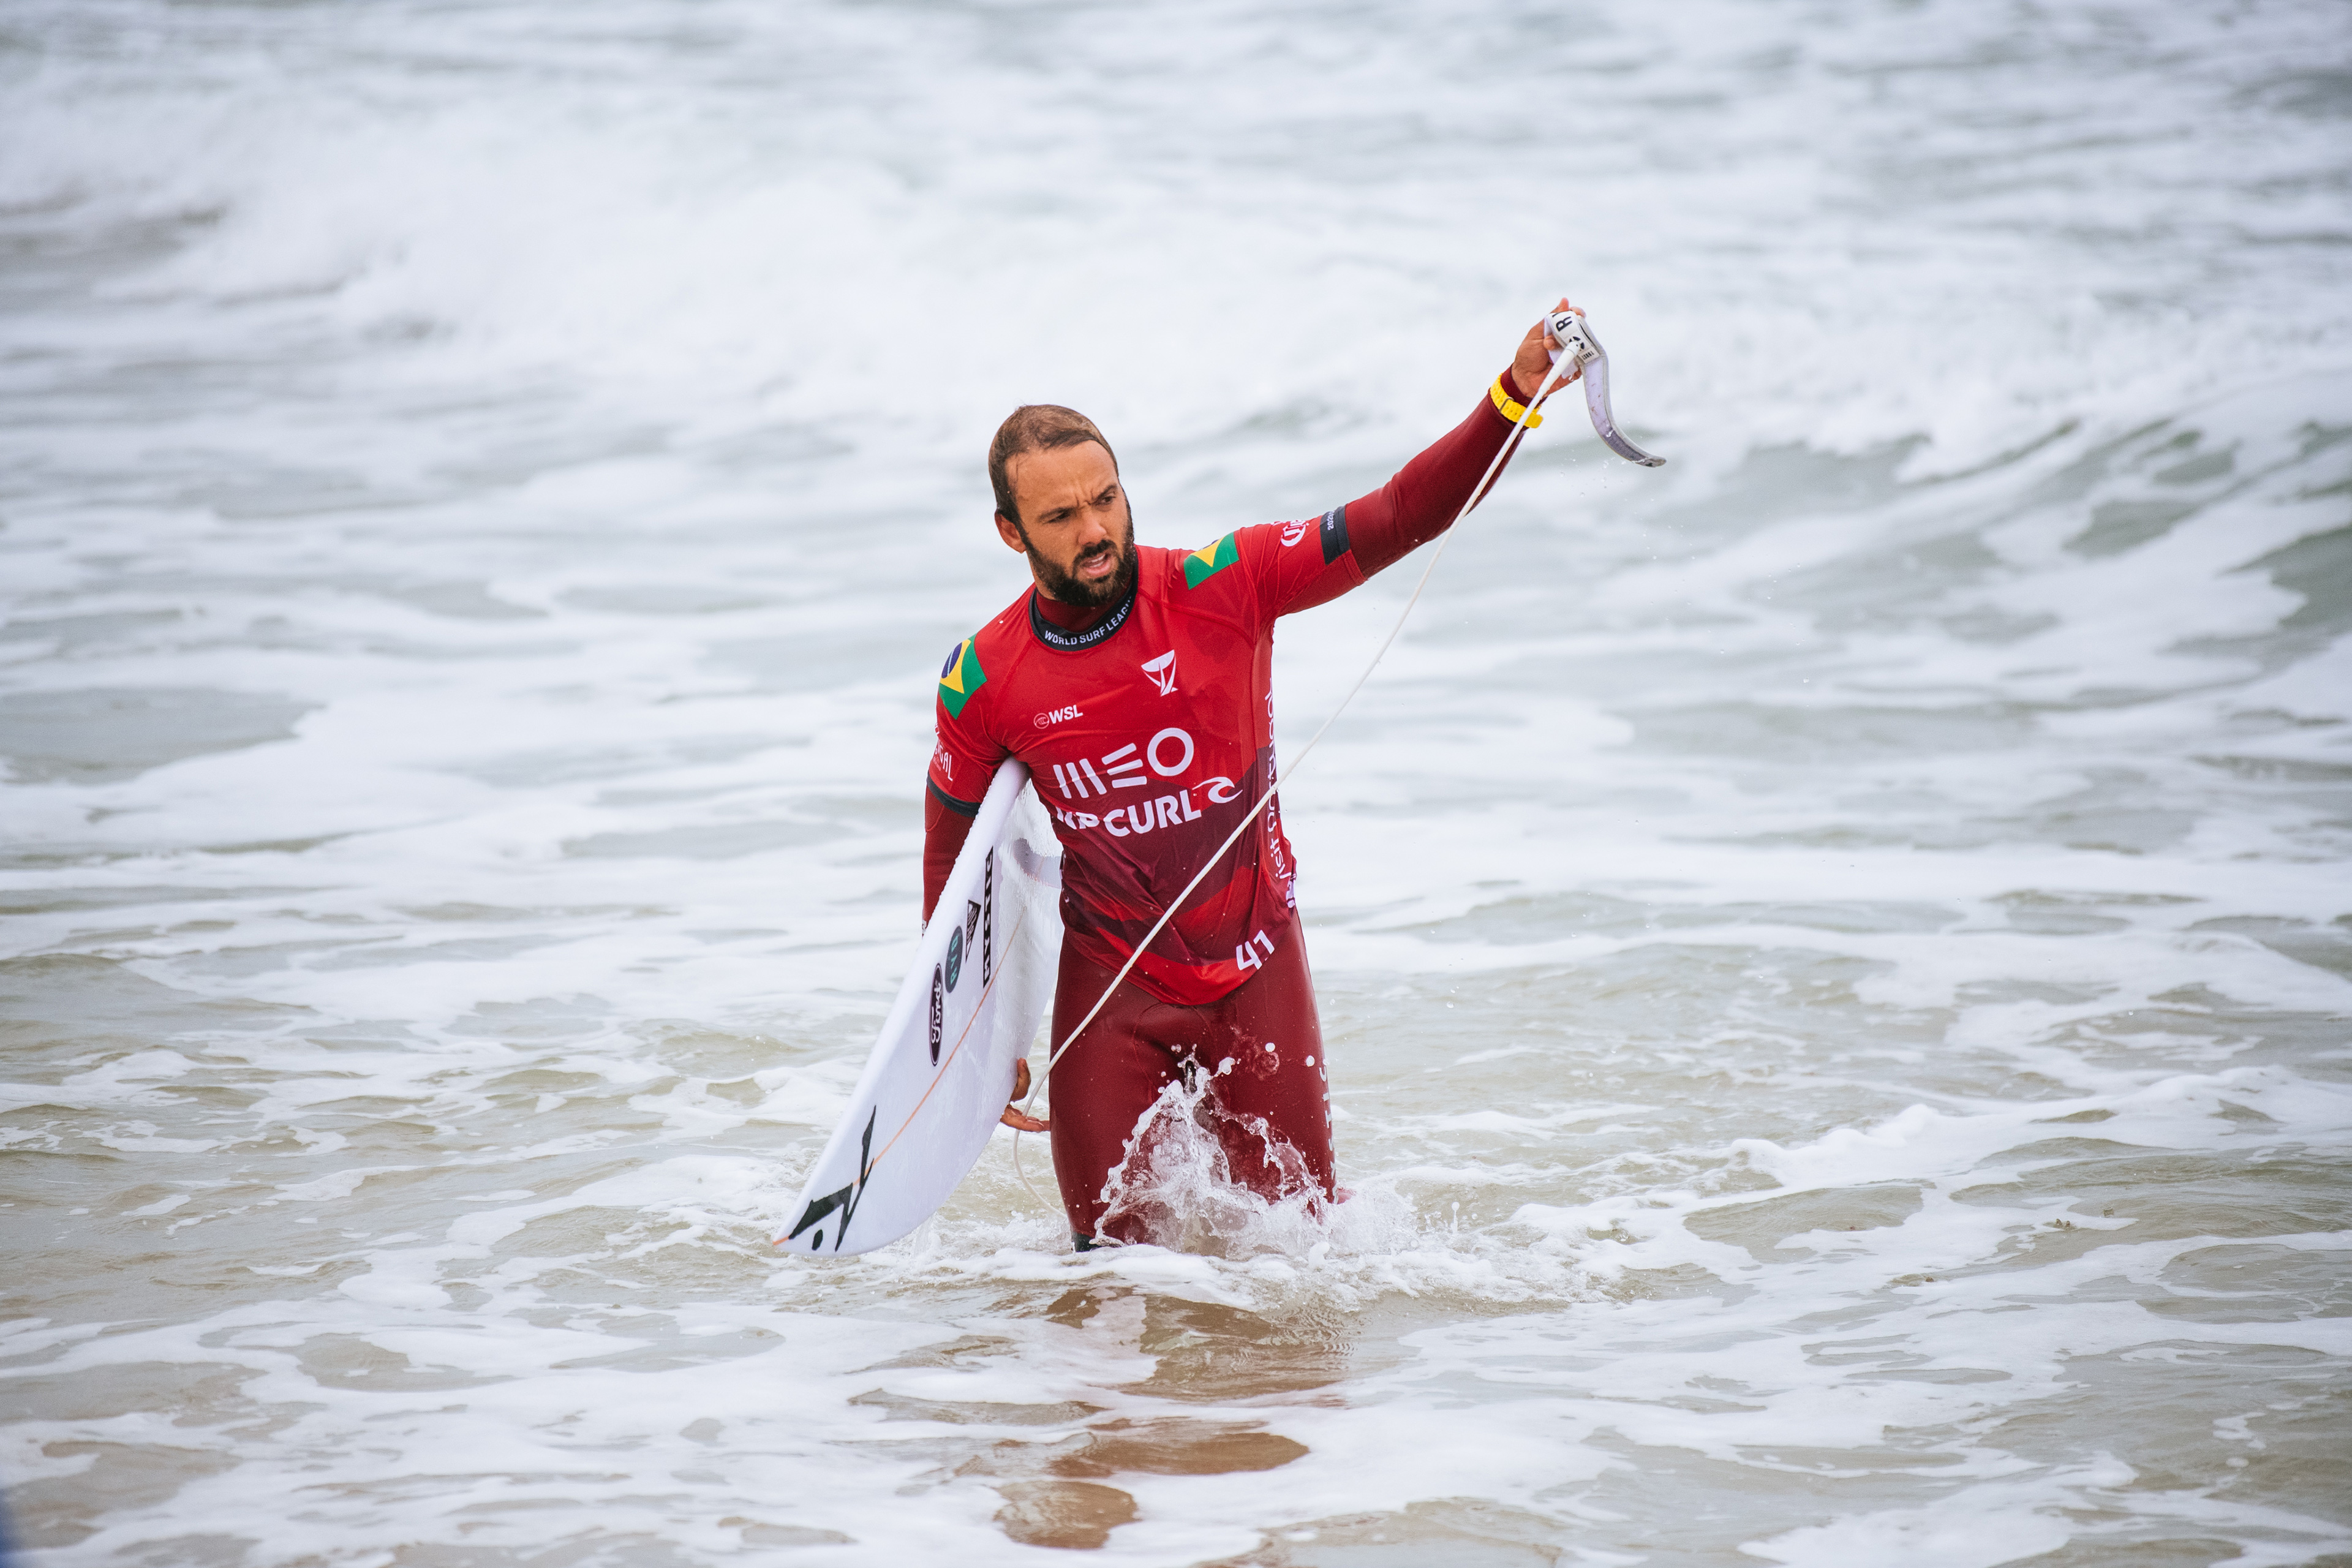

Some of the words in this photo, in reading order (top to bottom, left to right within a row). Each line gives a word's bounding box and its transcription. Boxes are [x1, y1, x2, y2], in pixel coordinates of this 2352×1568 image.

[1044, 630, 1077, 645] WORLD
[1079, 626, 1106, 644] SURF
[1049, 704, 1084, 724] WSL
[1053, 727, 1194, 799] MEO
[1103, 790, 1202, 837] CURL
[984, 854, 992, 981] MYSTIC
[1235, 929, 1275, 971] 41
[931, 982, 942, 1044] Ford
